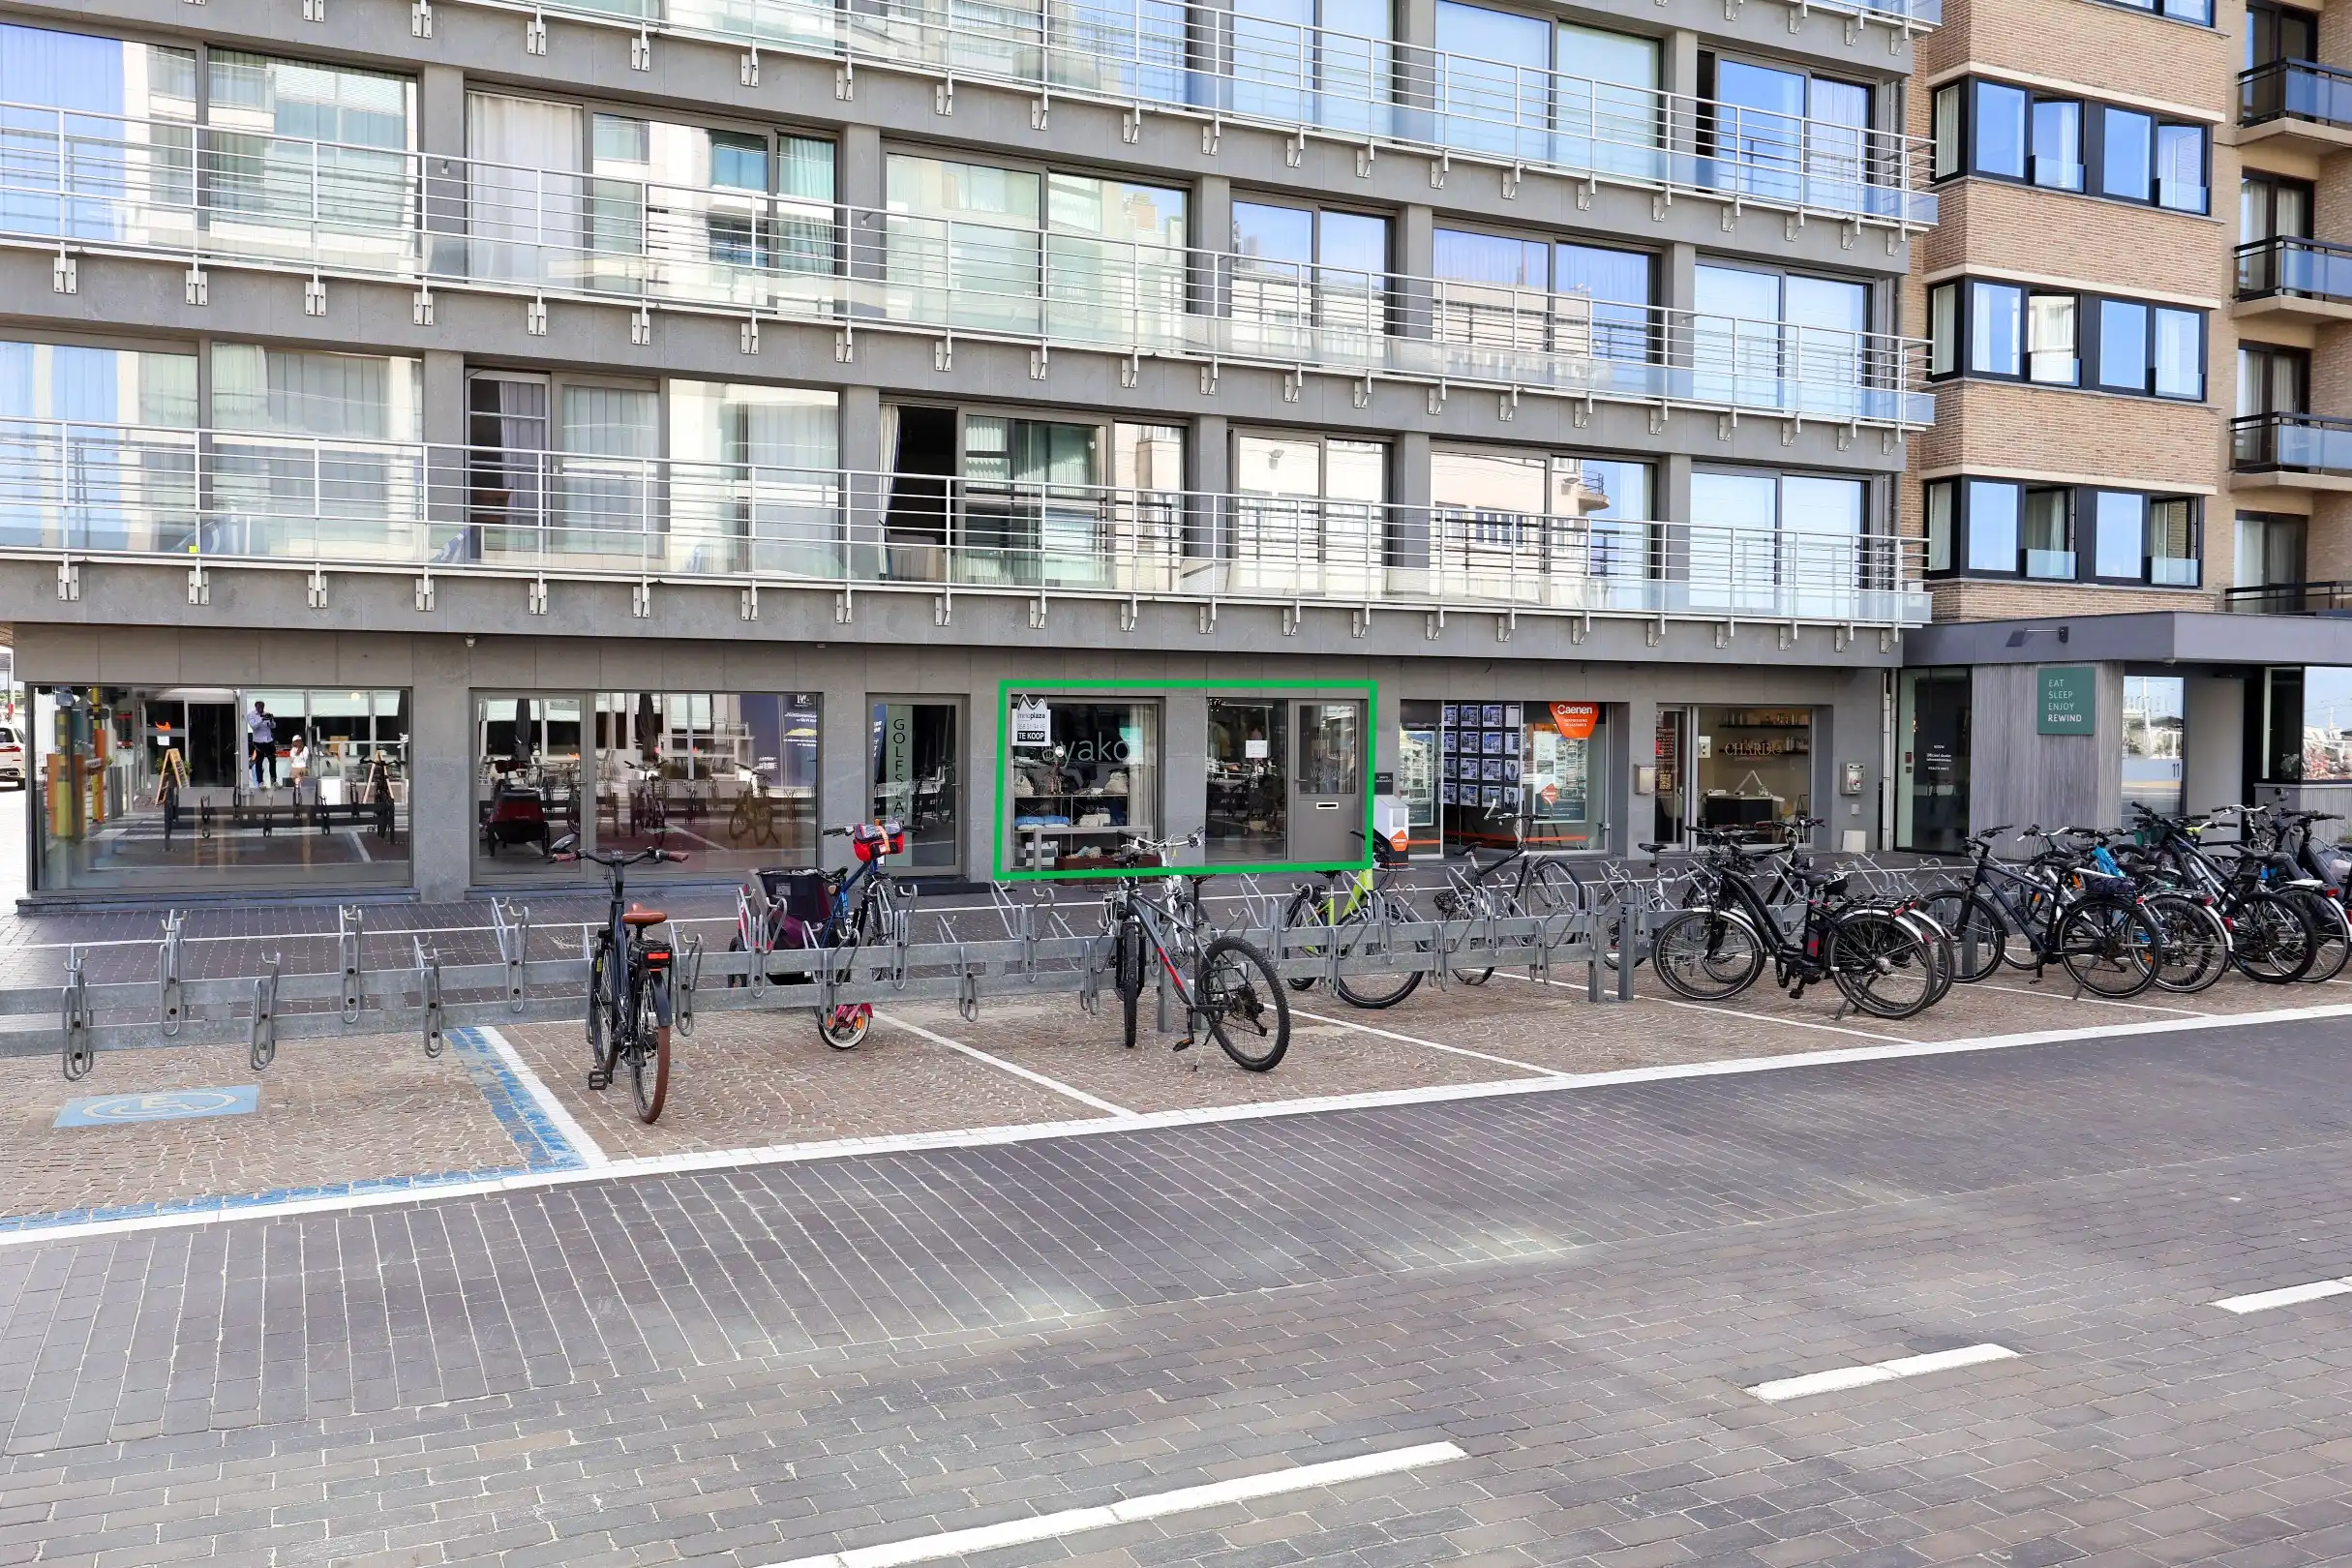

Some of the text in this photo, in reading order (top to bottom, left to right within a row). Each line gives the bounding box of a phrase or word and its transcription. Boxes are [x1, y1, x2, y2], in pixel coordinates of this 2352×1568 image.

[2048, 678, 2065, 687] EAT
[2048, 690, 2073, 699] SLEEP
[1556, 704, 1593, 715] Caenen
[2048, 702, 2074, 710] ENJOY
[2047, 713, 2082, 722] REWIND
[1041, 731, 1131, 768] ayako
[2172, 763, 2180, 777] 11
